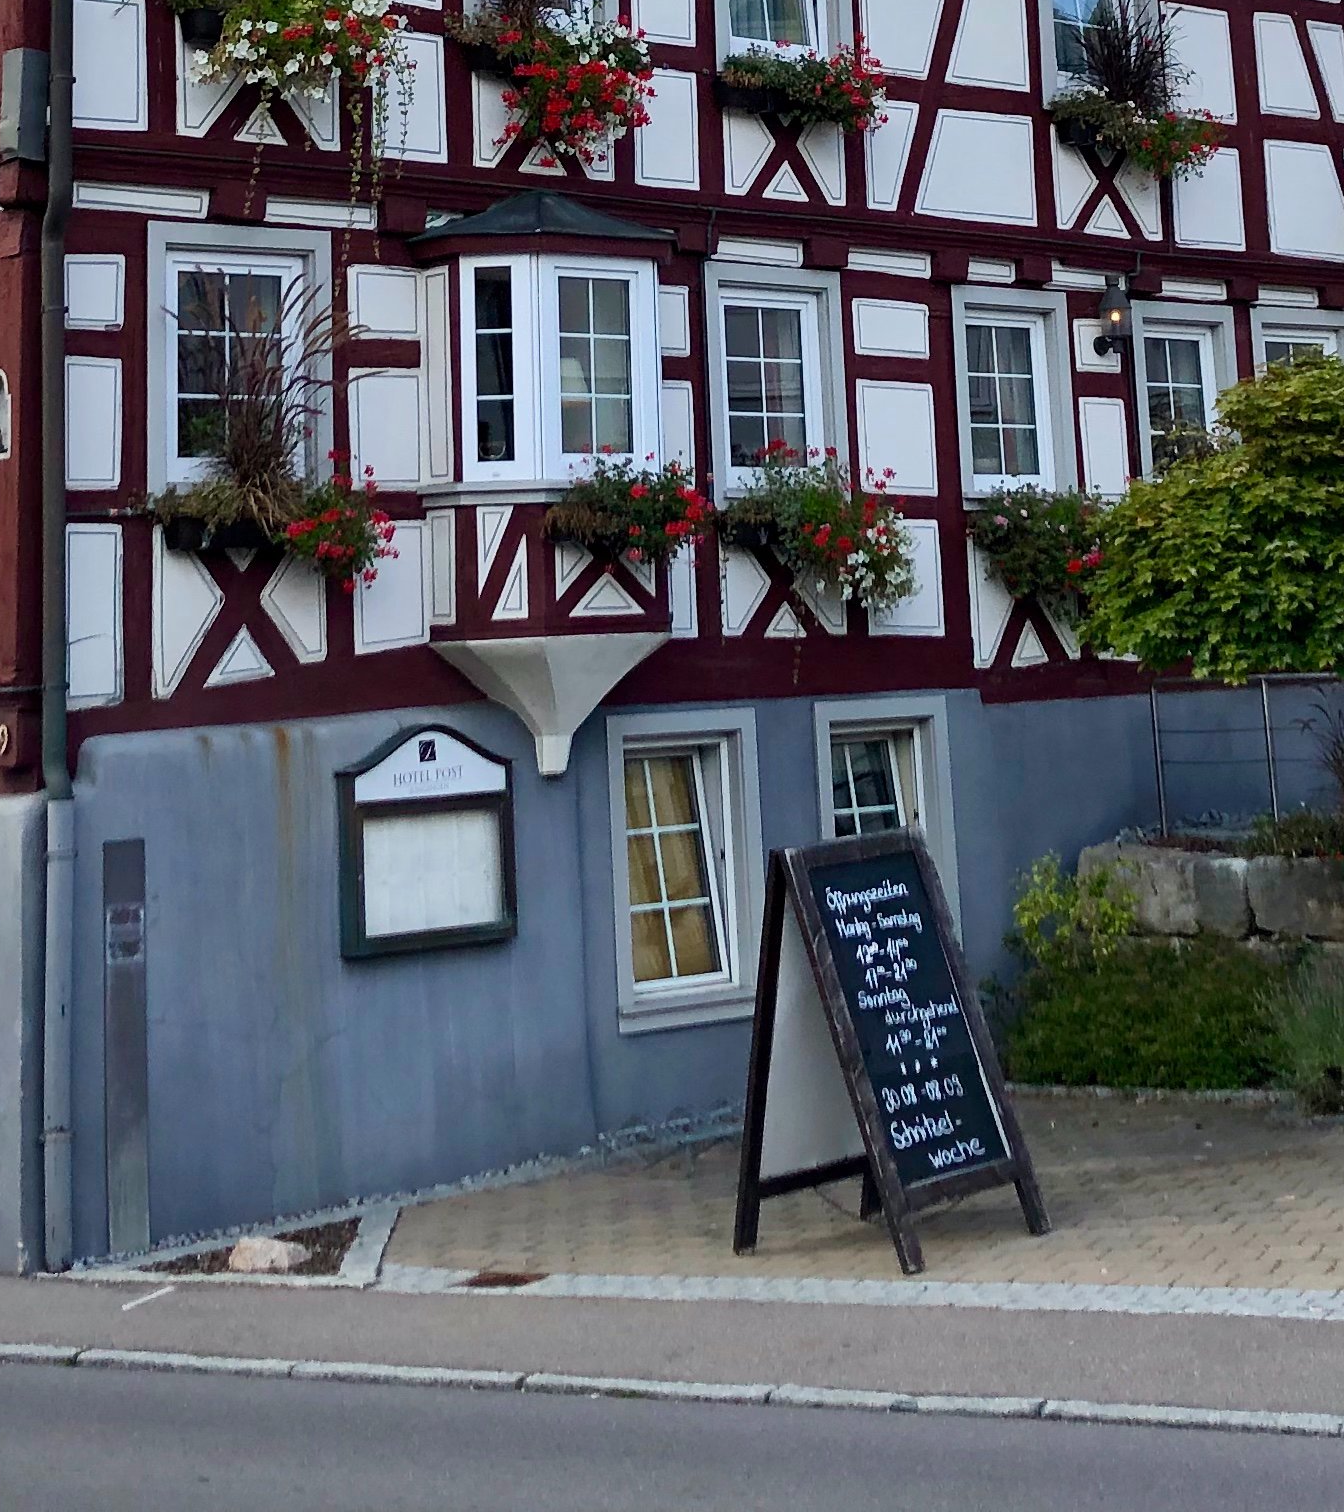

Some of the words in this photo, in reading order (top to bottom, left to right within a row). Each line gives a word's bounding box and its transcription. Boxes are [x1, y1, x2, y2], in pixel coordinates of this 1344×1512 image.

[393, 769, 430, 787] HOTEL
[435, 764, 463, 780] POST
[858, 986, 911, 1009] Sonntag
[885, 994, 959, 1031] durchgehend
